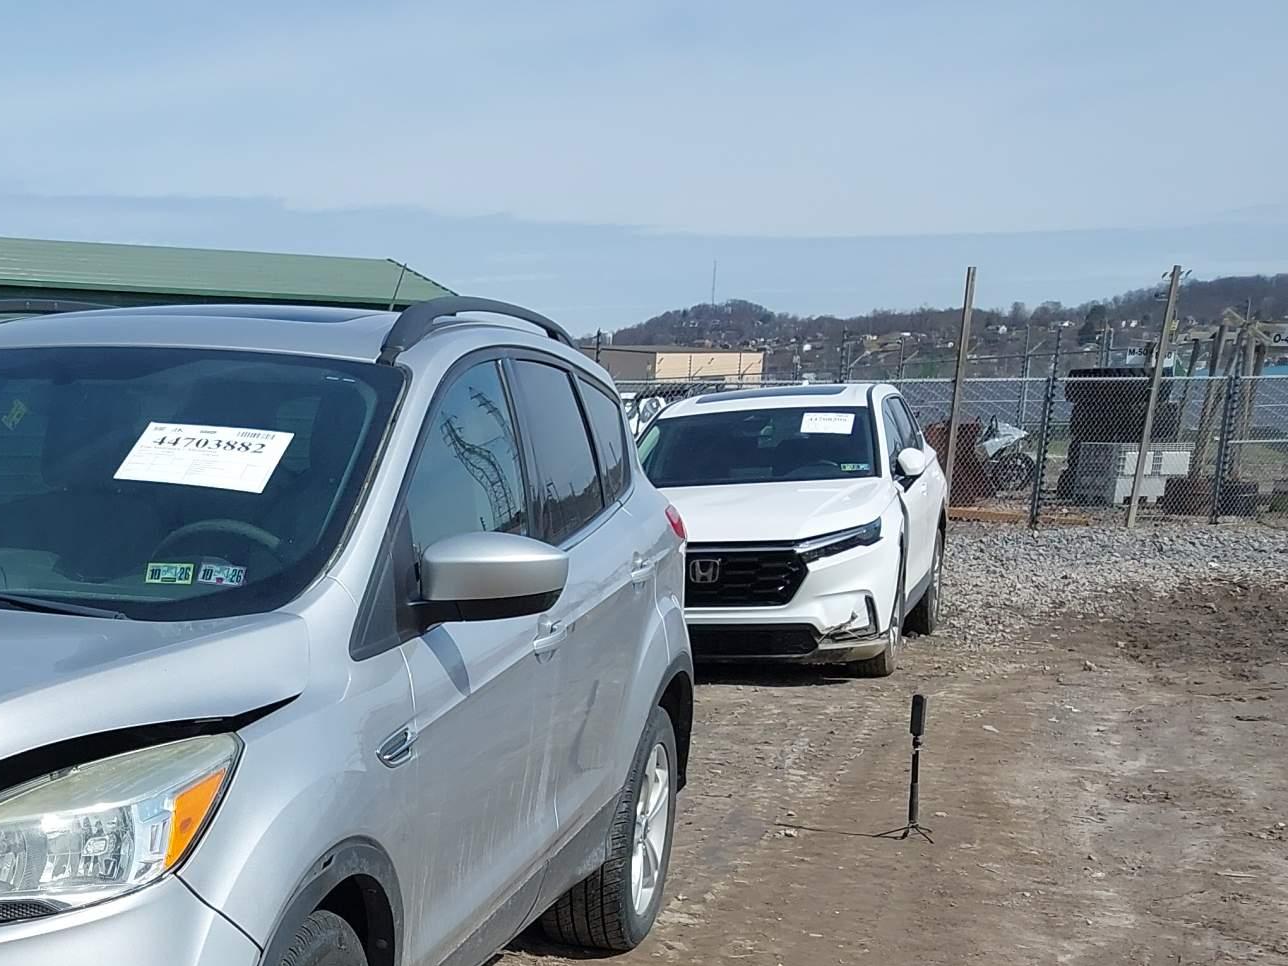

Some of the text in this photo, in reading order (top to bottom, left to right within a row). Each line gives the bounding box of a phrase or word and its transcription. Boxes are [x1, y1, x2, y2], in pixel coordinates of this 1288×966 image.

[153, 435, 266, 454] 44703882
[151, 566, 191, 581] 10 26
[202, 567, 243, 583] 10 26
